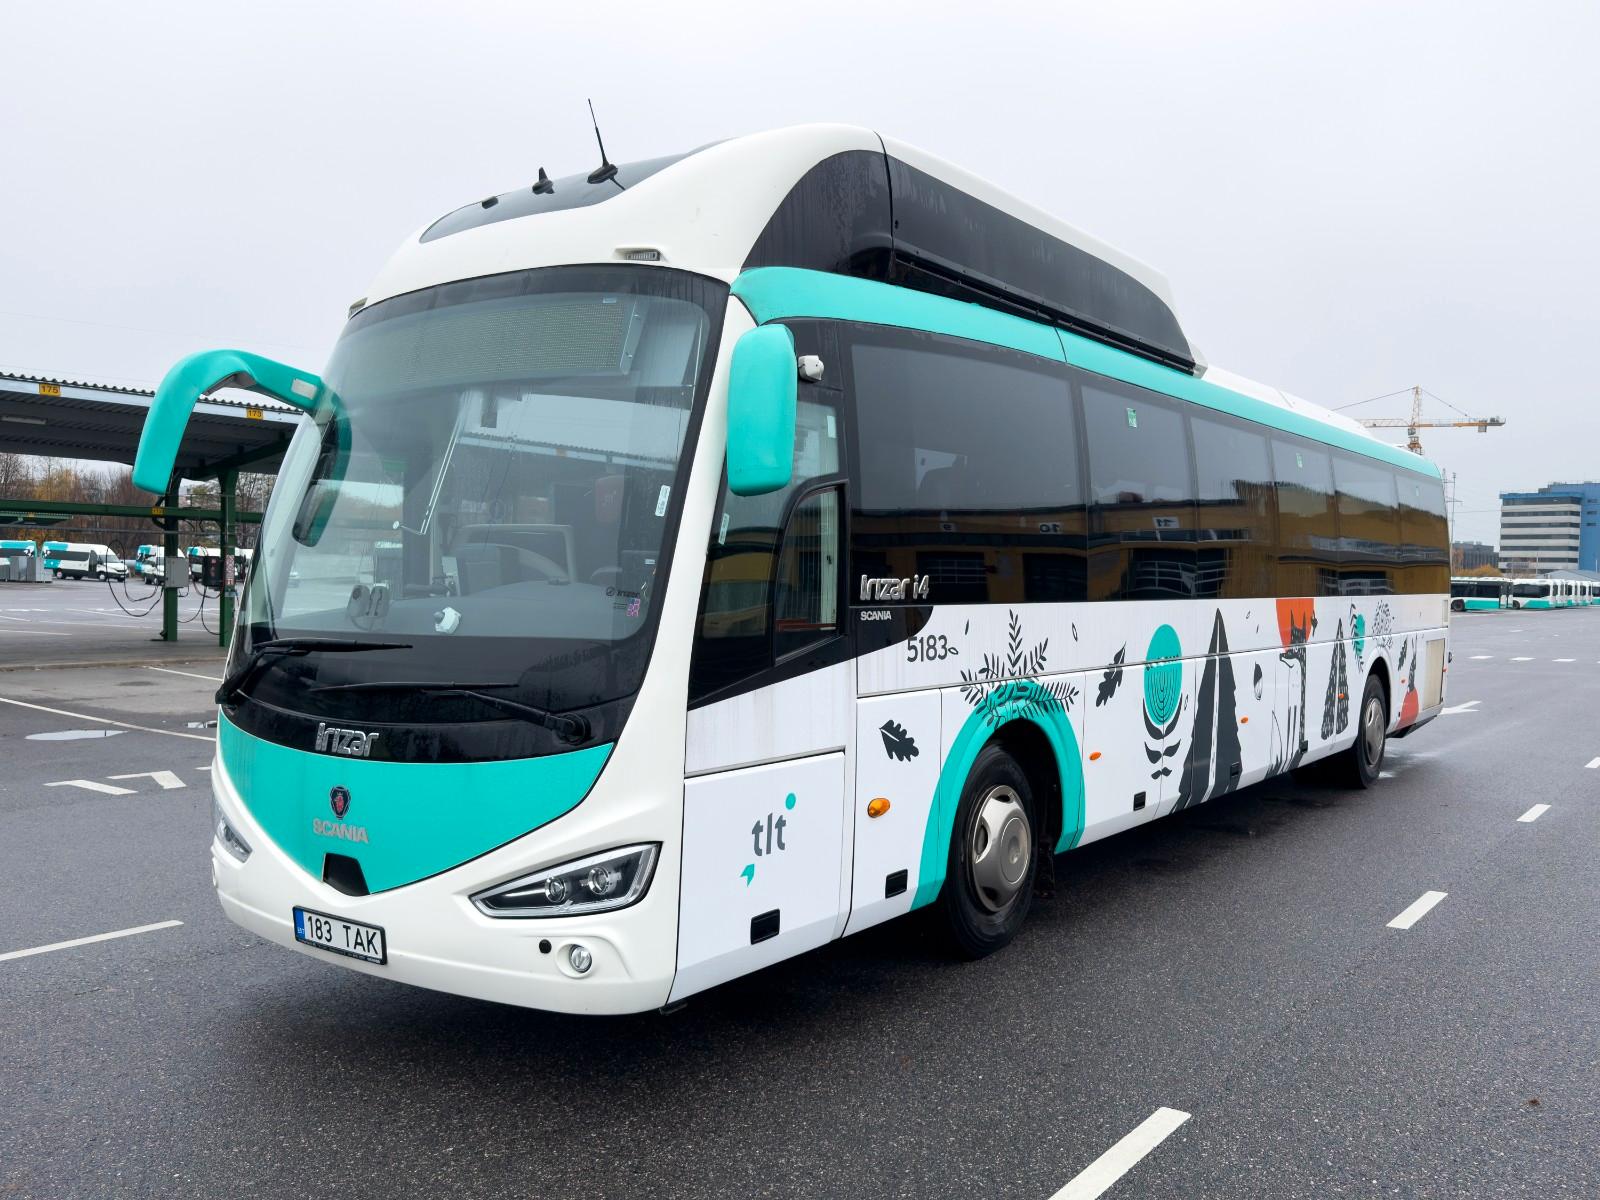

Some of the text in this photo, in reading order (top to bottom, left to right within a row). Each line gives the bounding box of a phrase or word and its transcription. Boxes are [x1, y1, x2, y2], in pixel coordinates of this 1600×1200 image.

[41, 385, 59, 394] 175
[912, 574, 930, 600] i4
[860, 610, 892, 621] SCANIA
[907, 634, 948, 663] 5183
[312, 818, 369, 844] SCANIA
[751, 812, 787, 857] tlt
[307, 915, 333, 943] 183
[342, 924, 379, 955] TAK
